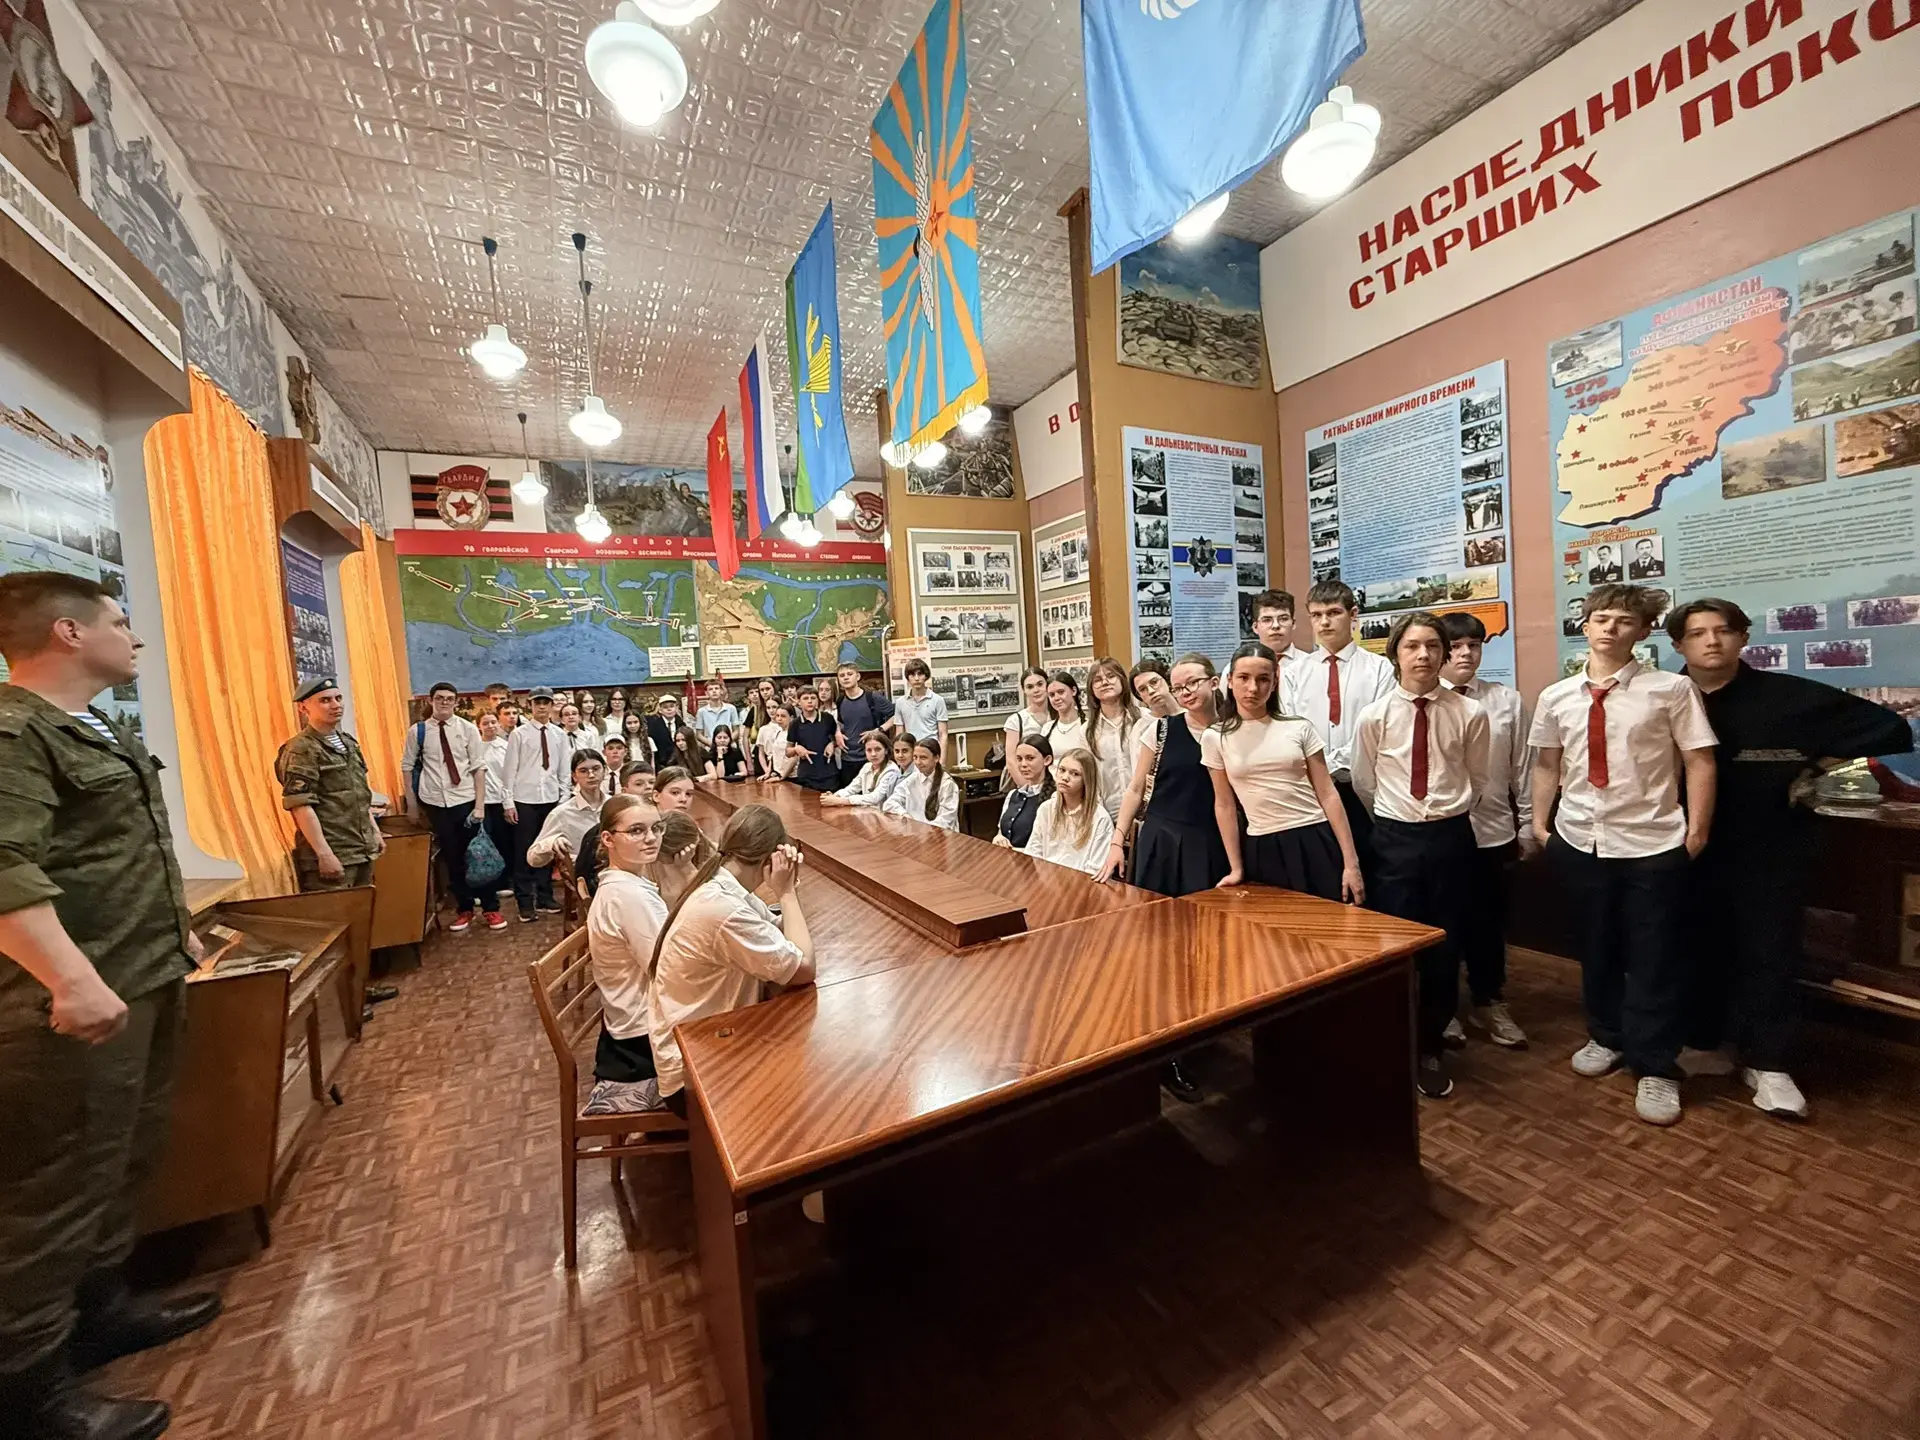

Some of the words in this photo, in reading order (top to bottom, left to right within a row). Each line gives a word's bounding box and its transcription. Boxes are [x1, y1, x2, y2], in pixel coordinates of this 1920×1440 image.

[1358, 0, 1803, 263] НАСЛЕДНИКИ
[1349, 150, 1602, 310] СТАРШИХ
[1653, 275, 1762, 326] АФНИСТАН
[1323, 419, 1355, 440] РАТНЫЕ
[1355, 408, 1384, 428] БУДНИ
[1385, 394, 1428, 418] МИРНОГО
[1430, 376, 1476, 403] ВРЕМЕНИ
[1564, 375, 1608, 398] 1979
[1144, 435, 1154, 446] НА
[1155, 436, 1219, 454] ДАЛЬНЕВОСТОЧНЫХ
[1221, 446, 1248, 458] РУБЕЖАХ
[614, 537, 689, 546] ОЕВОЙ
